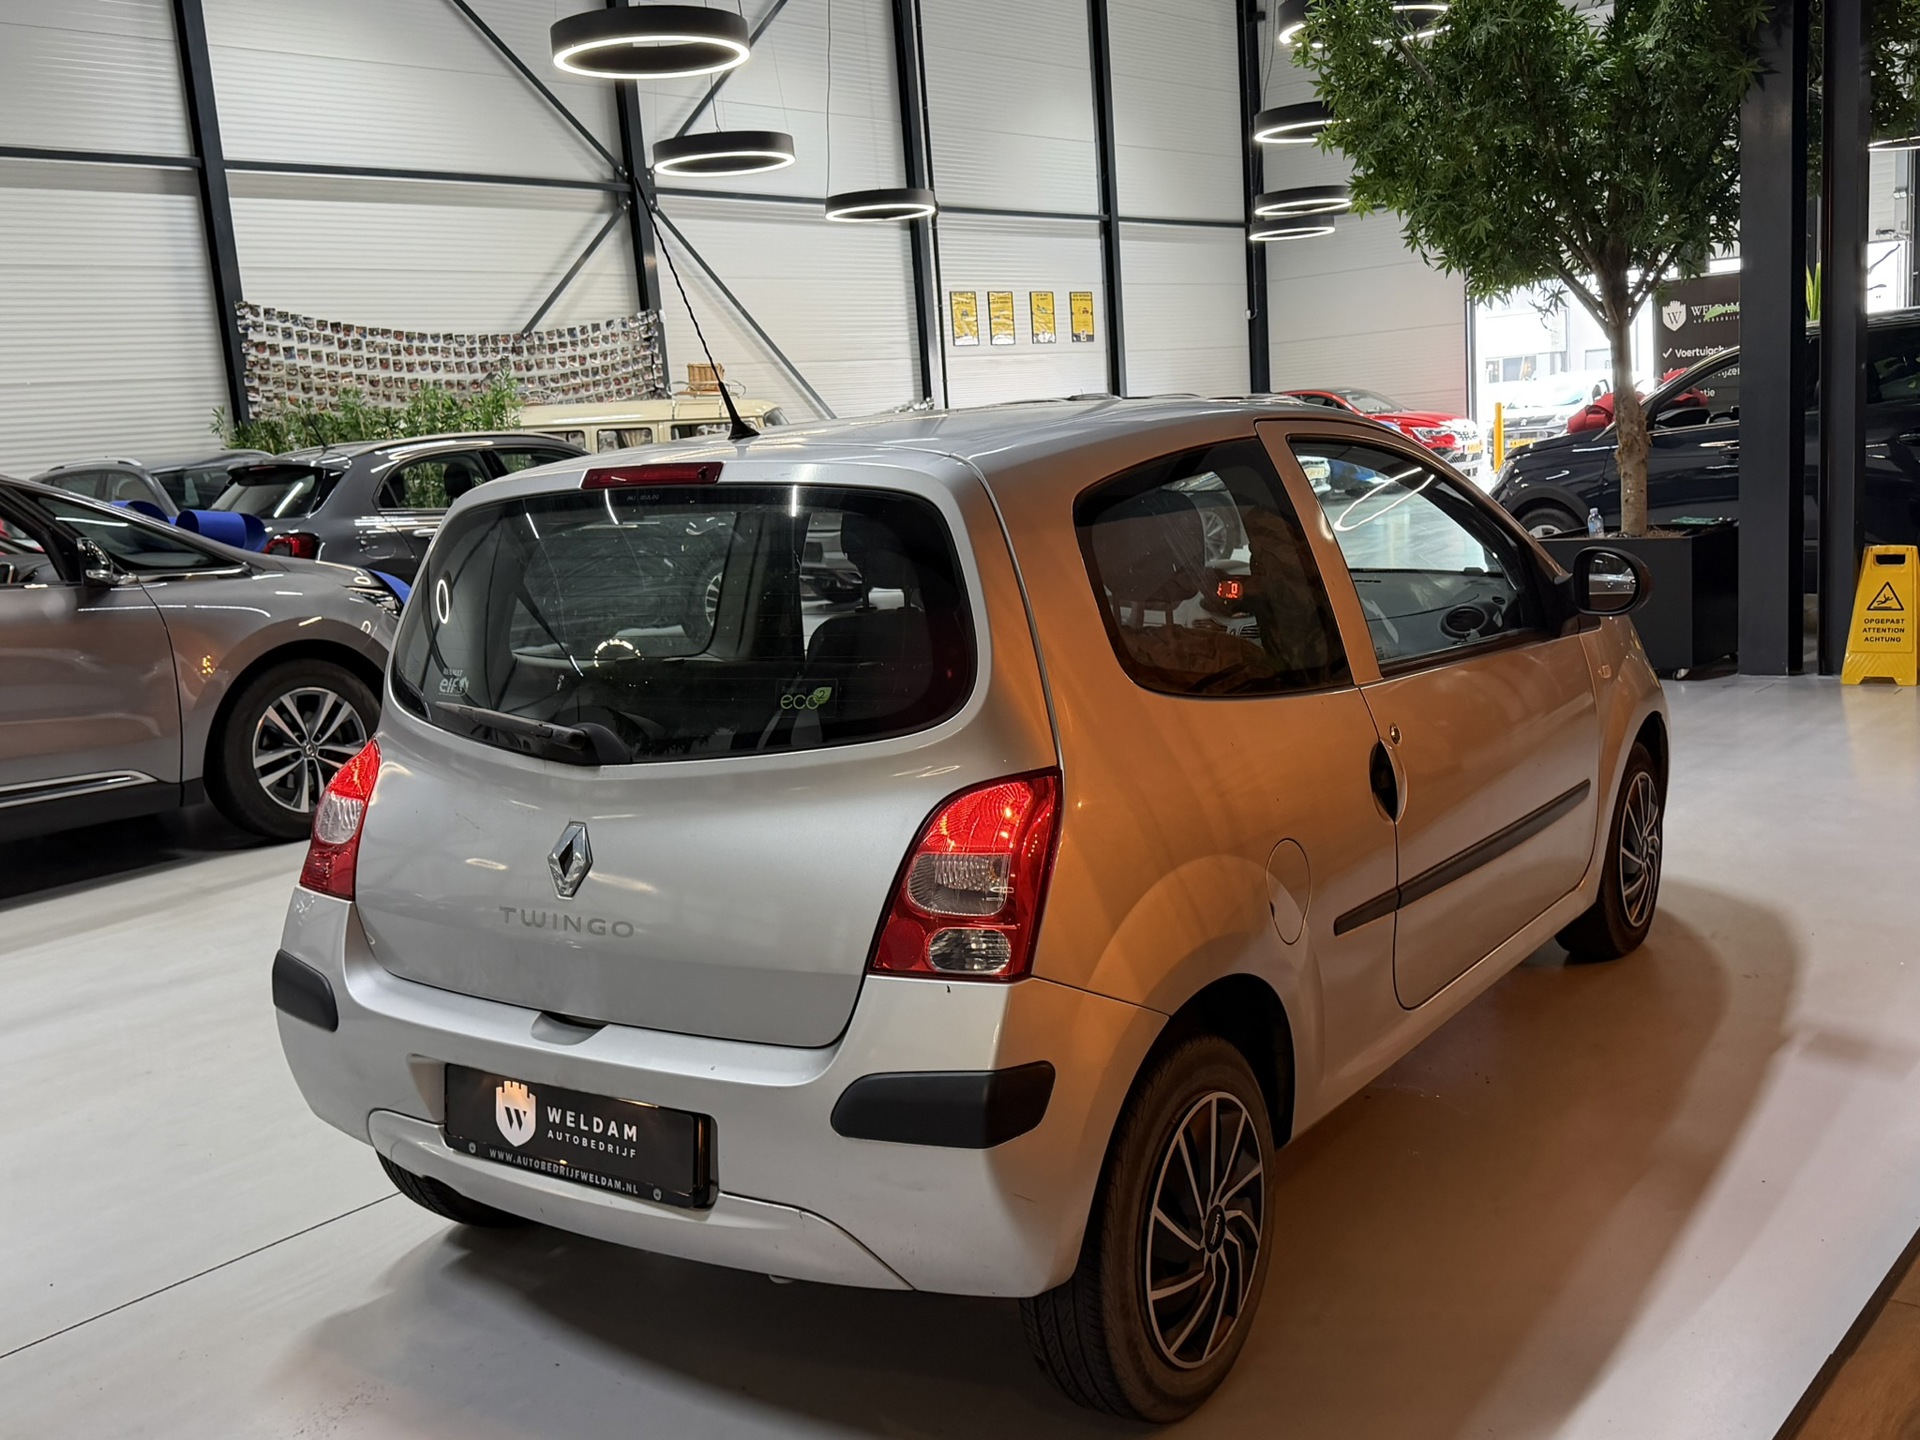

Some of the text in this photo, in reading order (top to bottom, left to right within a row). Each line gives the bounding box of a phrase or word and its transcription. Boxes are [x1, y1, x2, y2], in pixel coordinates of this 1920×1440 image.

[1863, 617, 1905, 625] OPGEPAST
[439, 677, 459, 694] elf
[499, 905, 635, 939] TWINGO
[505, 1106, 527, 1132] W
[547, 1106, 638, 1143] WELDAM
[547, 1130, 637, 1159] AUTOBEDRIJF
[489, 1148, 639, 1195] WWW.AUTOBEDRIJFWELDAM.NL
